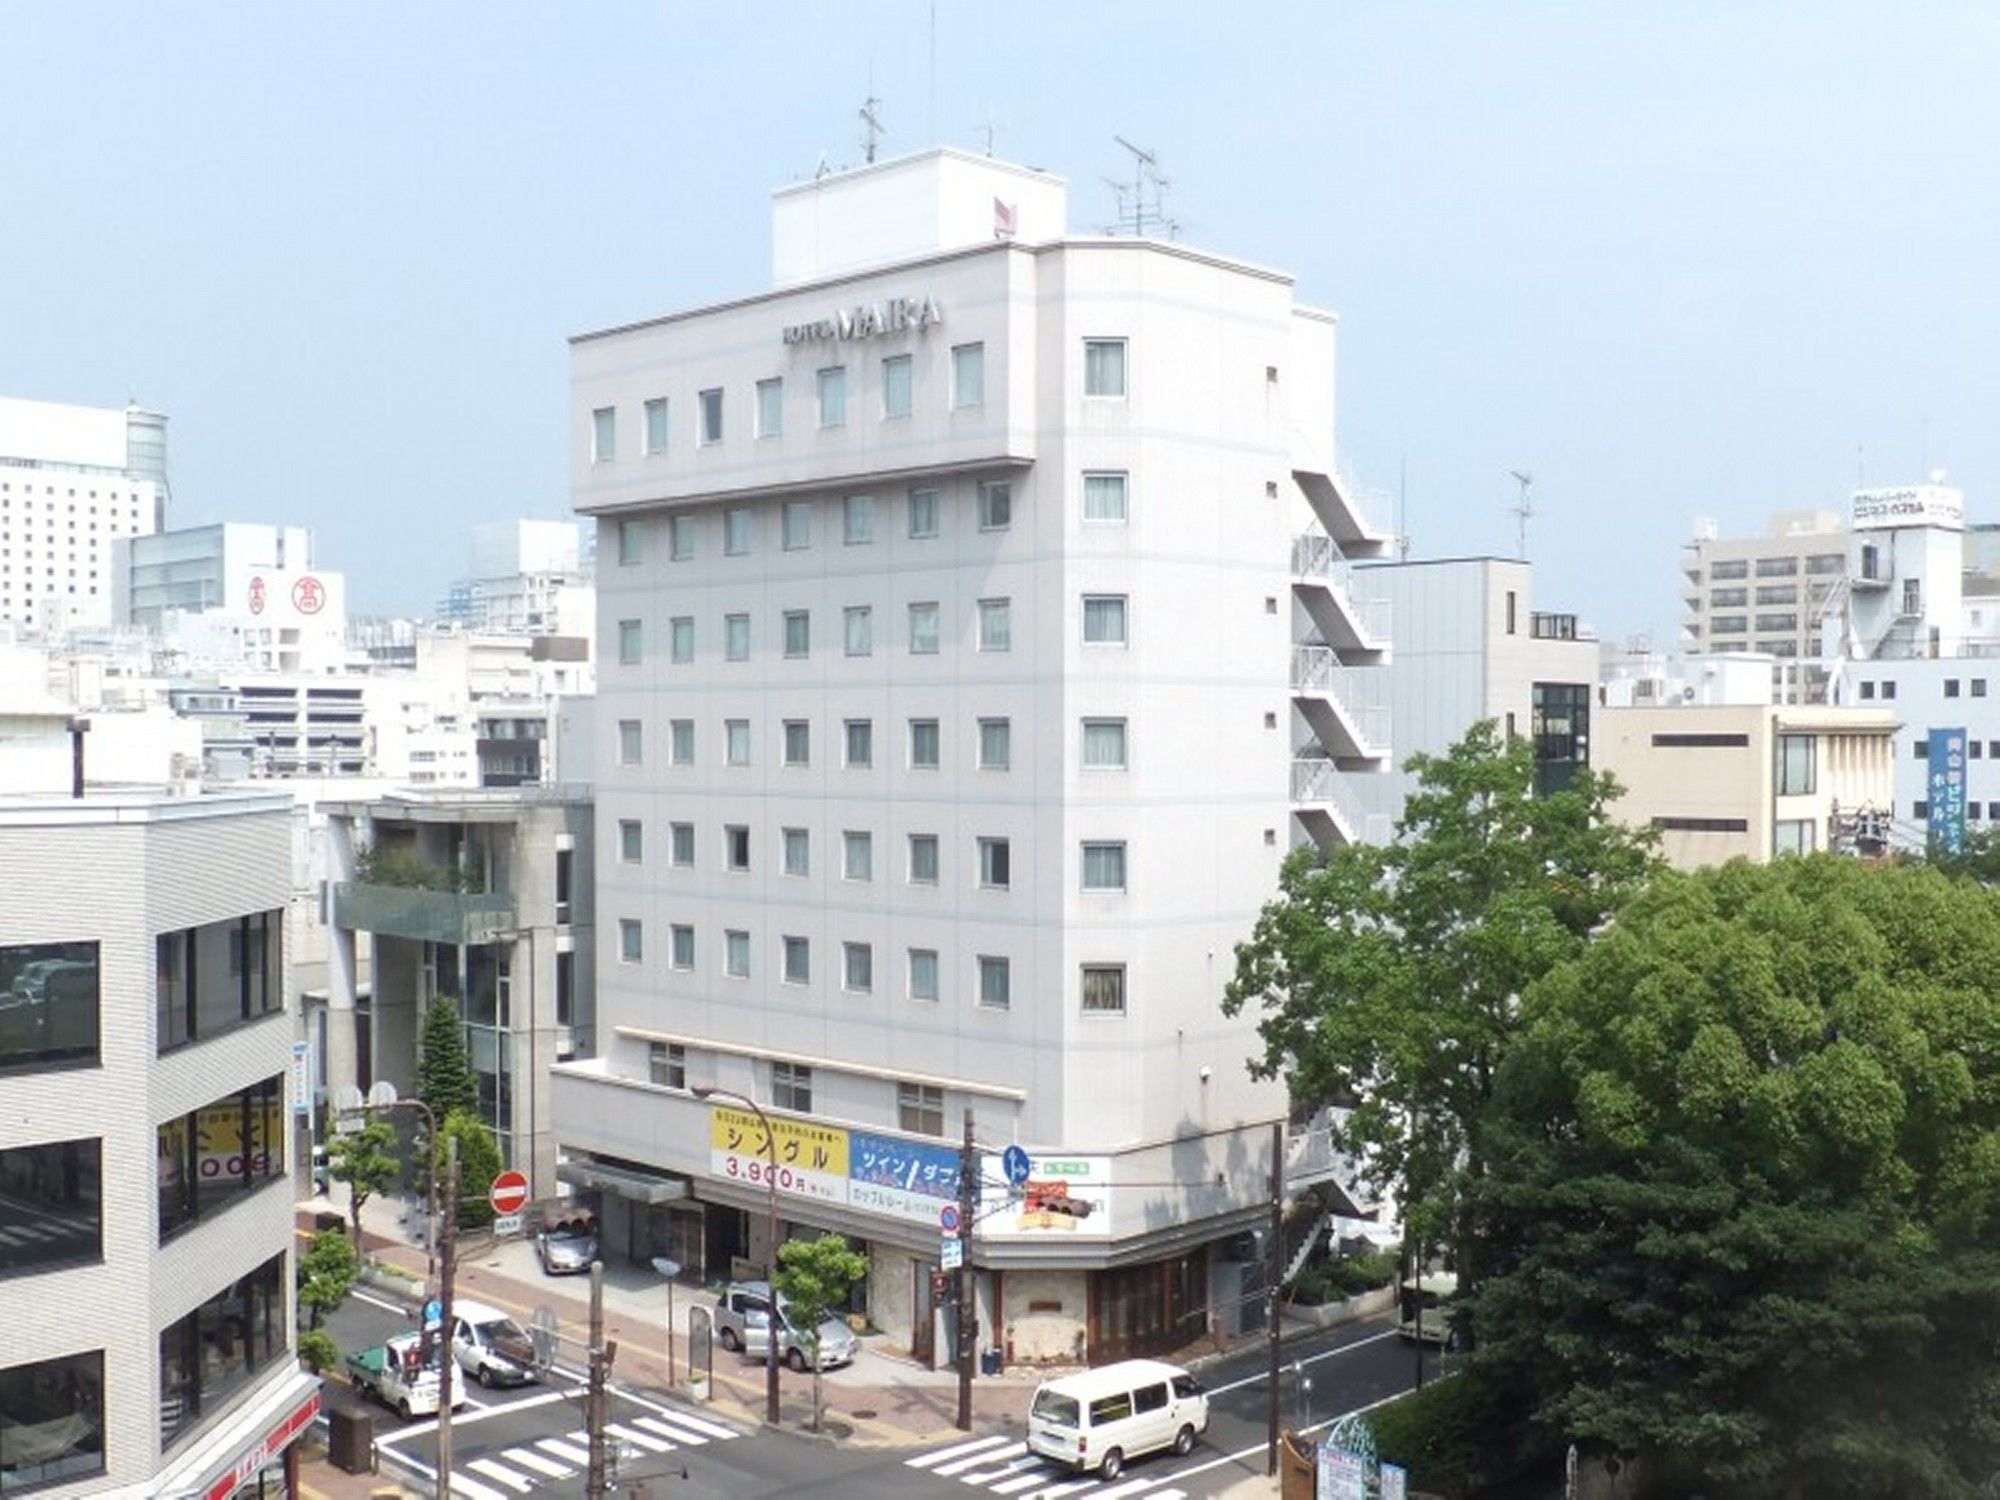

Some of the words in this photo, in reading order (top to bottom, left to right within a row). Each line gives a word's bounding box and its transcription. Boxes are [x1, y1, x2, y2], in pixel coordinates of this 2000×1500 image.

[837, 294, 942, 343] MAIRA
[727, 1127, 829, 1169] シングル
